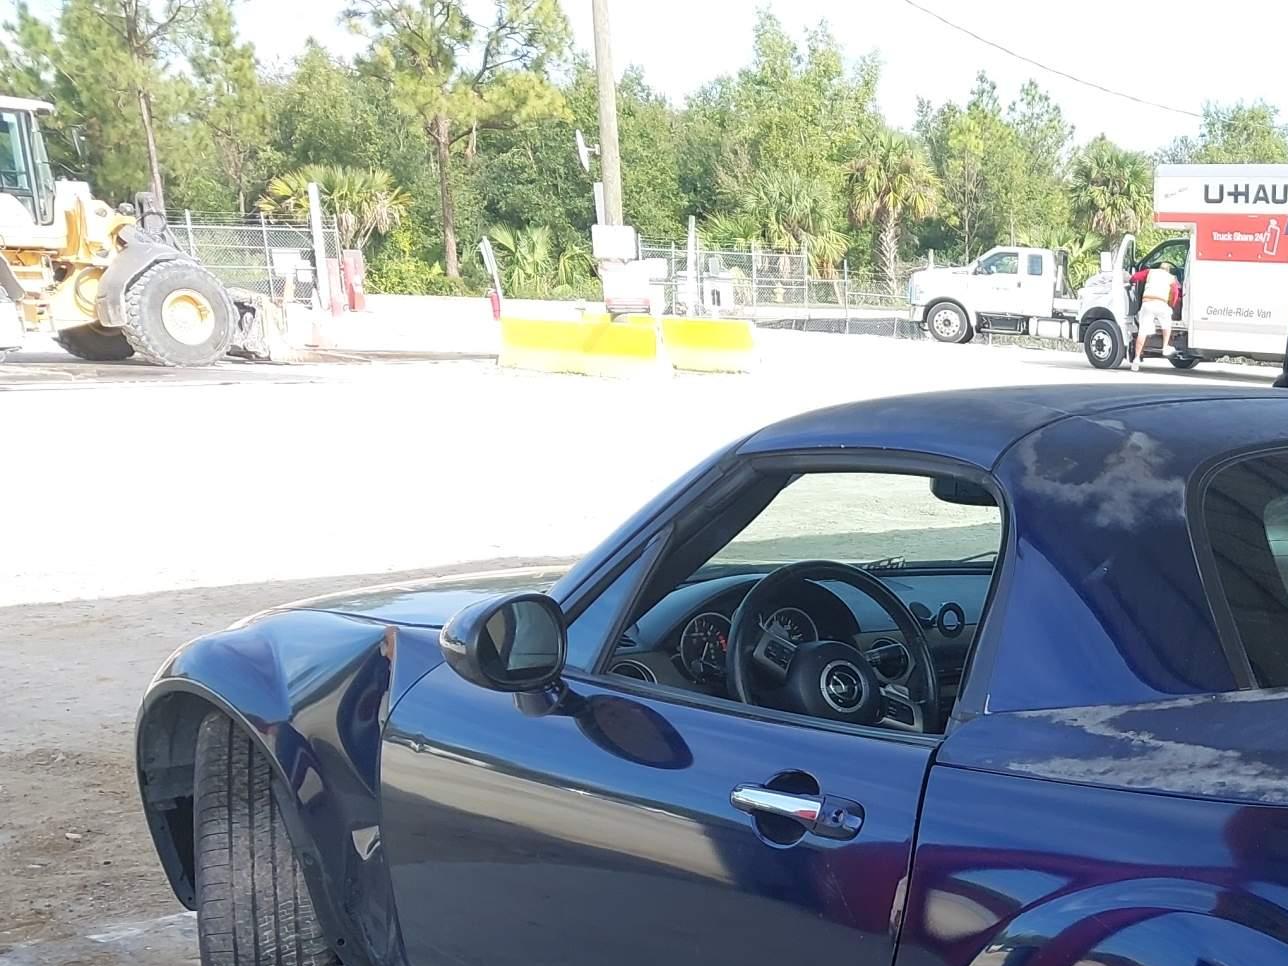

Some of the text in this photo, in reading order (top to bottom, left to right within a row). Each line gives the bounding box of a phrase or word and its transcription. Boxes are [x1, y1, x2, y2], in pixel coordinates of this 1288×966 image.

[1212, 231, 1232, 241] Truck
[1233, 231, 1254, 242] Share
[1206, 305, 1272, 319] Gentle-Ride Van
